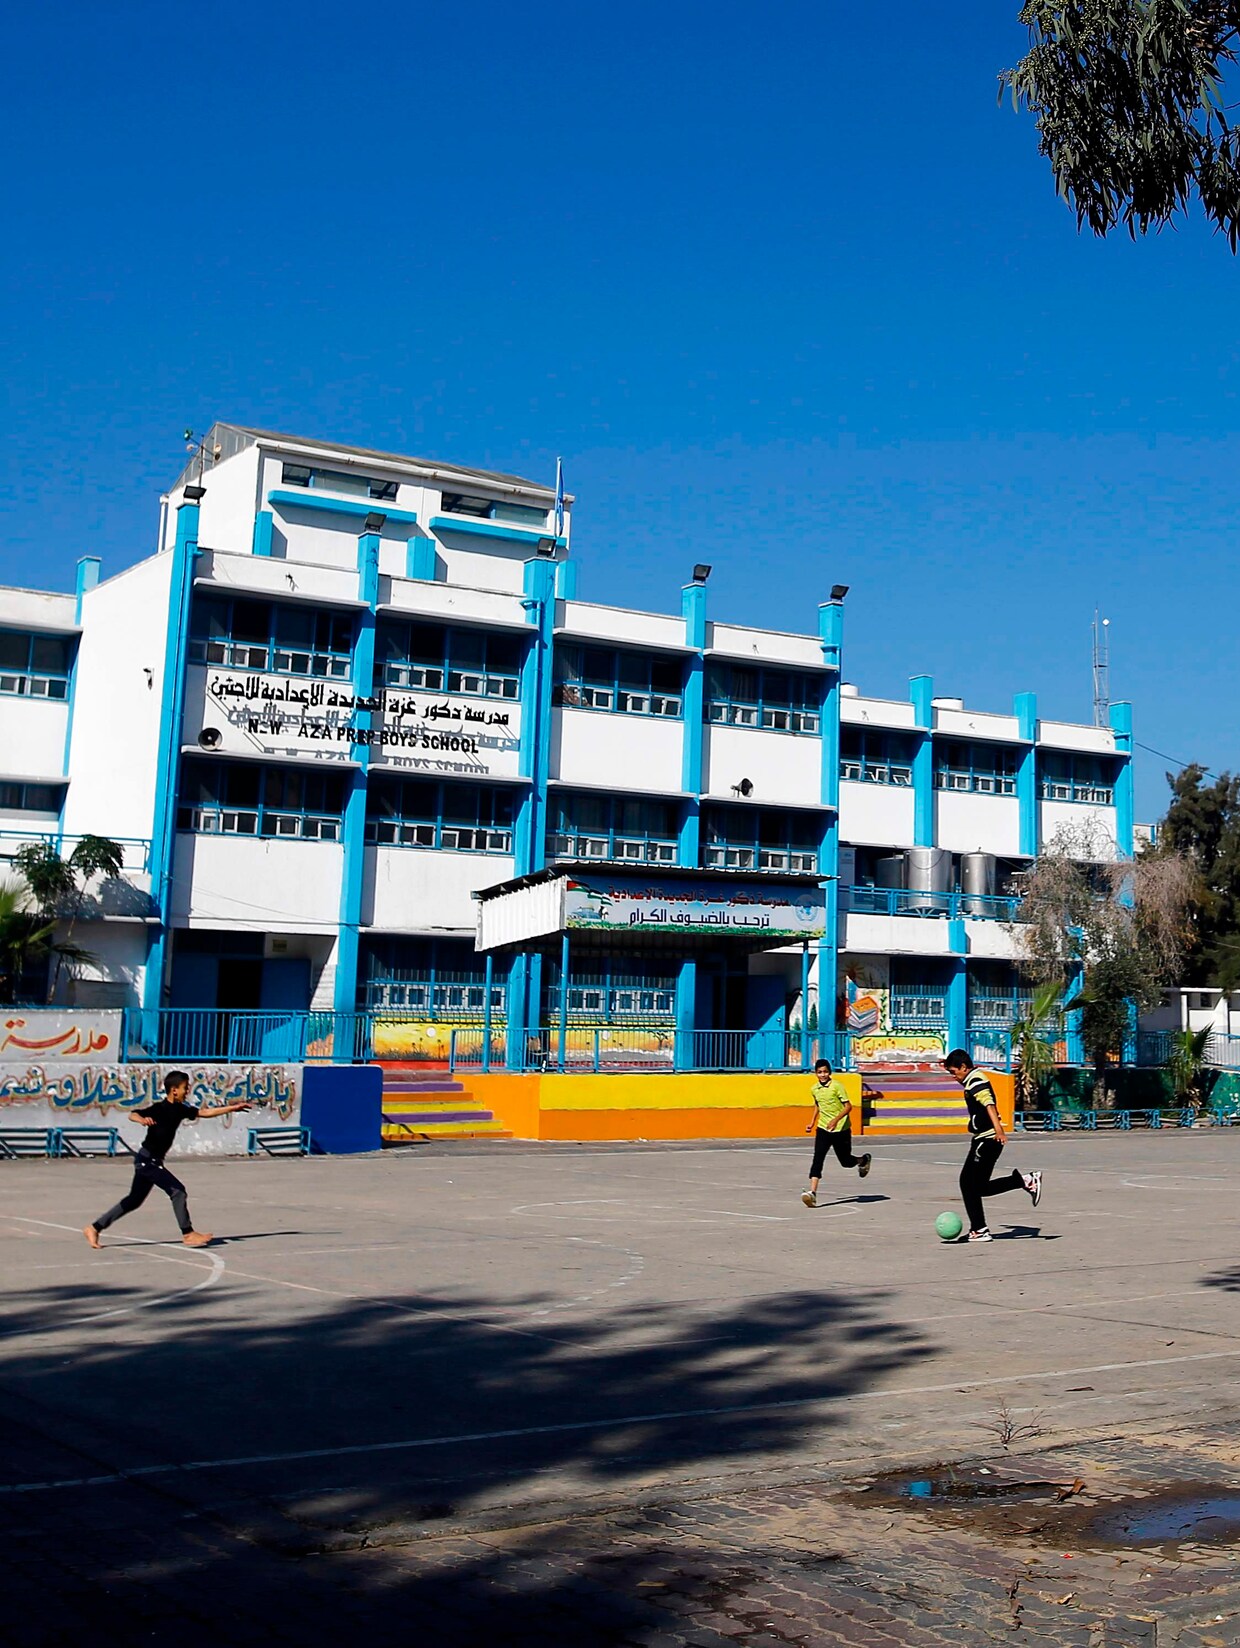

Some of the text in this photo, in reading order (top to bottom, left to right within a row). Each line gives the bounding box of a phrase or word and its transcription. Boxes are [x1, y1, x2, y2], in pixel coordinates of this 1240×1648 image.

[388, 696, 416, 719] غزة
[464, 705, 510, 726] مدرسة
[248, 718, 282, 735] NW
[336, 728, 376, 746] PREP
[380, 729, 417, 748] BOYS
[421, 733, 480, 754] SCHOOL
[629, 907, 770, 929] ترحب بالضيوف الكرام
